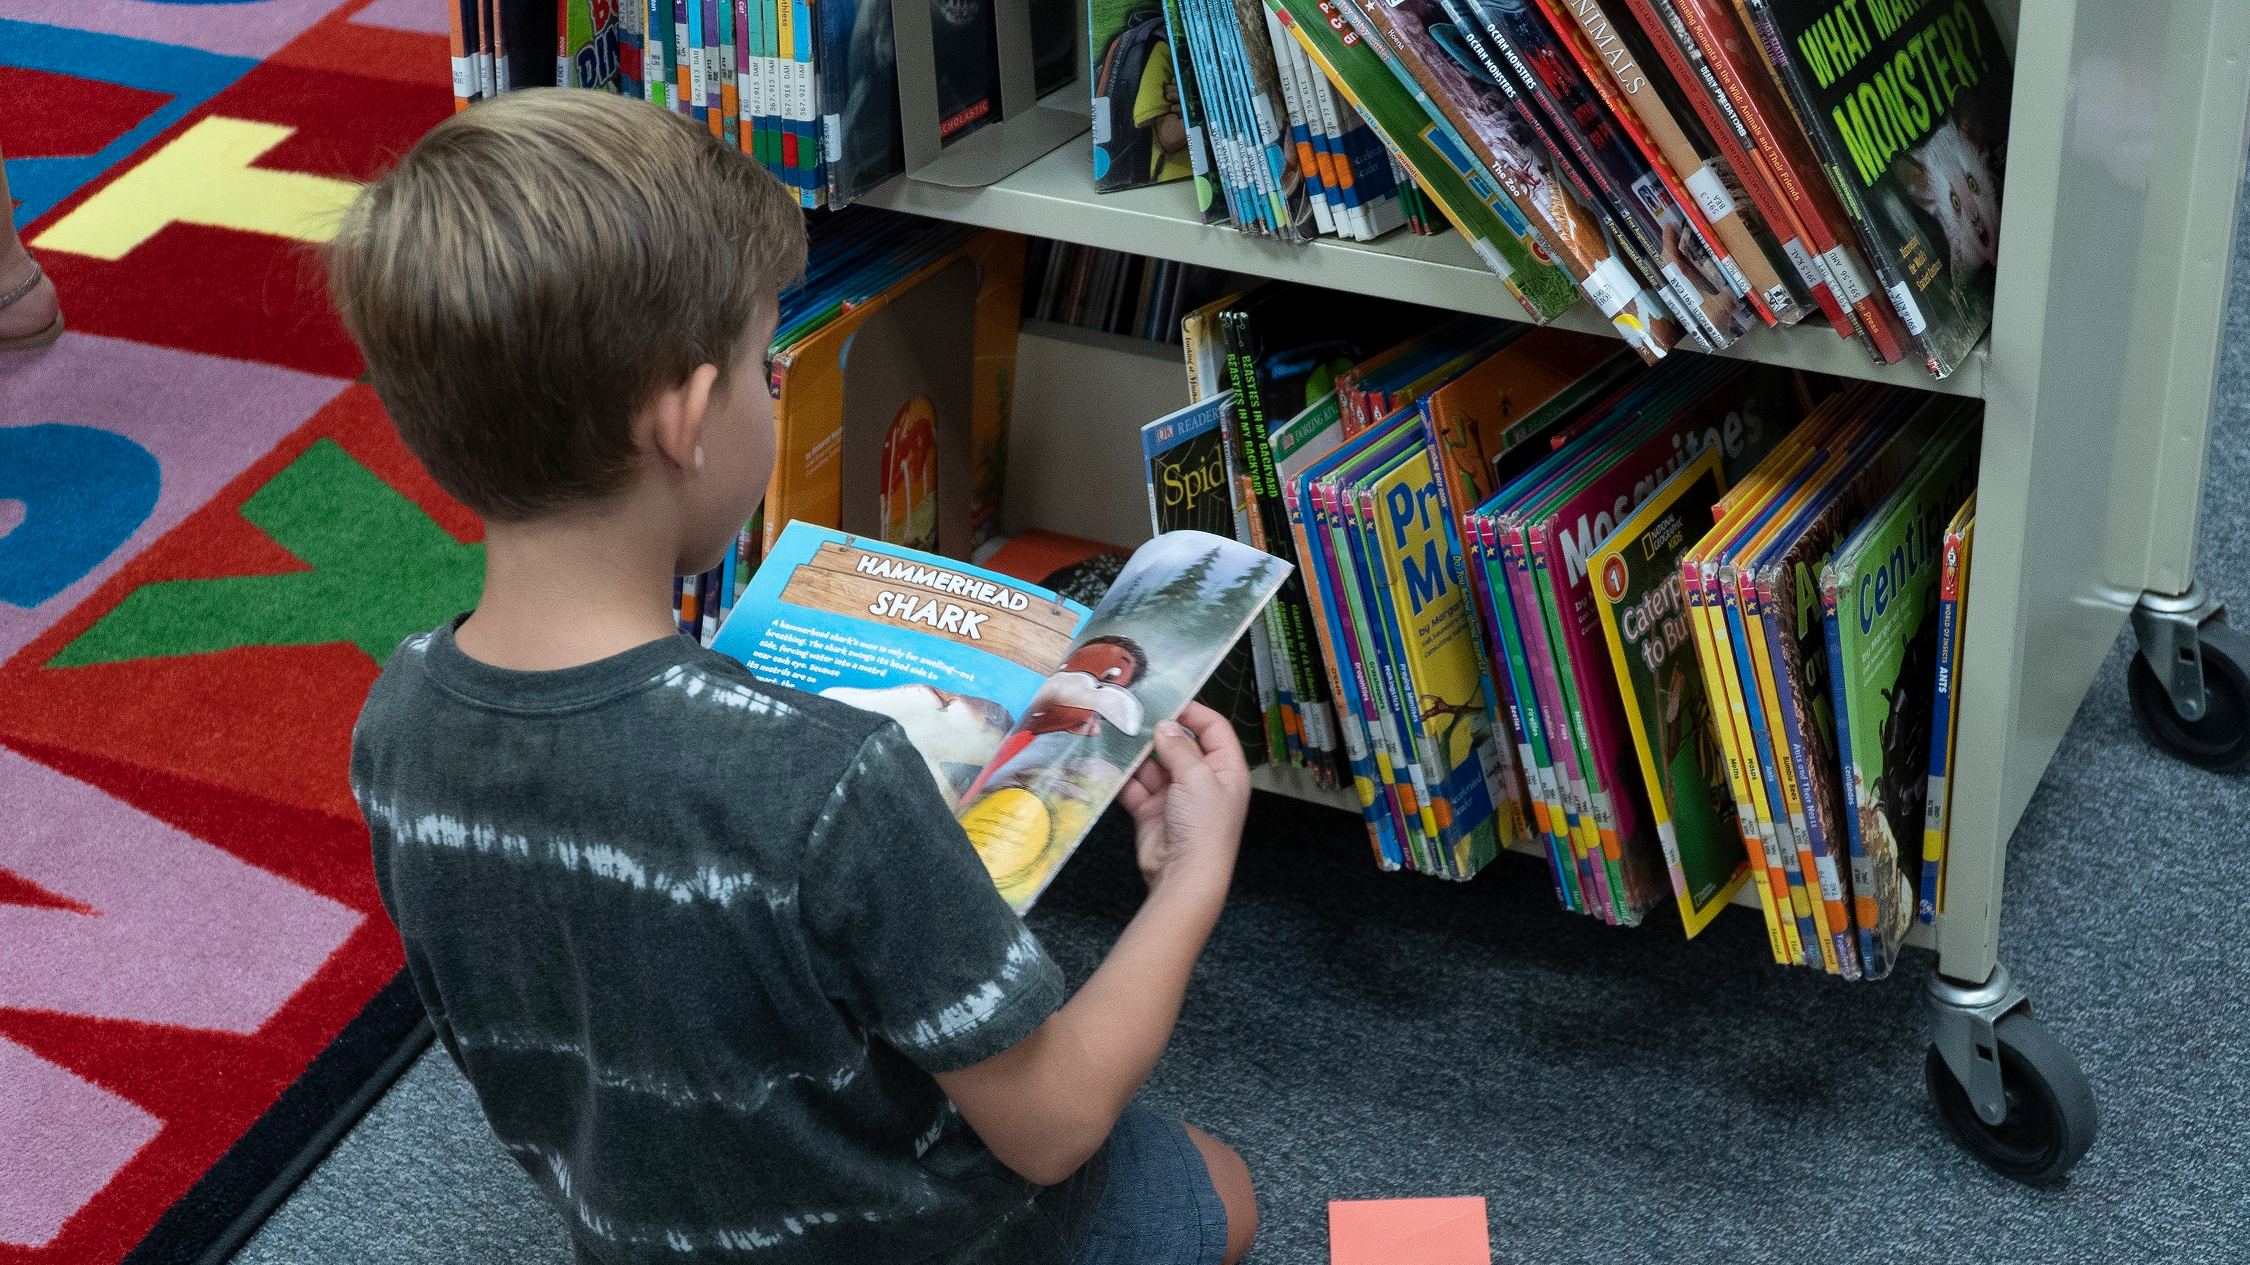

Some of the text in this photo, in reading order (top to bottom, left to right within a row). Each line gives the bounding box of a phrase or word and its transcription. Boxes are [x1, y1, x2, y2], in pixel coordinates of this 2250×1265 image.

[1351, 14, 1389, 60] Bitsy Cuties
[1657, 34, 1678, 63] ANIMALS
[1764, 19, 1790, 66] JESS KEATING
[1796, 0, 1872, 90] WHAT
[1466, 33, 1516, 98] OCEAN MONSTERS
[1487, 22, 1536, 89] OCEAN MONSTERS
[693, 68, 701, 101] 567.913
[753, 80, 761, 114] 567.915
[768, 78, 776, 111] 567.915
[783, 83, 792, 116] 567.918
[798, 84, 806, 116] 567.921
[1281, 76, 1290, 92] KLI
[1300, 80, 1309, 95] KLI
[1317, 88, 1327, 103] KLI
[1700, 65, 1746, 137] DEADLY PREDATORS
[1832, 0, 1989, 187] MONSTER?
[1693, 24, 1800, 201] Moments in the Wild: Animals and Their Friends
[1352, 104, 1418, 177] my little book of animals
[1491, 160, 1520, 197] The Zoo
[1699, 191, 1719, 217] 591.3
[1712, 194, 1725, 212] BEA
[1626, 215, 1657, 256] Free Augmented
[1609, 221, 1658, 286] Free Augmented Reality App
[1790, 248, 1815, 283] 591.5 KAL
[1829, 252, 1842, 266] AMU
[1593, 283, 1611, 301] 590.7
[1669, 277, 1692, 306] 591 CAR
[1723, 258, 1746, 293] 591 McG
[1817, 264, 1845, 310] 591.53 DEL
[1840, 269, 1861, 298] 591.56
[1664, 302, 1677, 318] CAR
[1863, 311, 1879, 333] Press
[1892, 292, 1916, 332] 591.6 KEA
[1185, 336, 1193, 365] Looking
[1227, 353, 1244, 405] BEASTIES
[1237, 408, 1247, 420] IN
[1240, 421, 1251, 437] MY
[1242, 355, 1278, 497] BEASTIES IN MY BACKYARD
[1157, 425, 1173, 441] DK
[1163, 446, 1228, 510] Spid
[1244, 440, 1263, 495] BACKYARD
[1651, 512, 1676, 541] NATIONAL
[1668, 533, 1684, 551] KIDS
[856, 554, 1029, 612] HAMMERHEAD
[1452, 555, 1470, 610] Do You Know
[1609, 569, 1622, 593] 1
[868, 590, 990, 640] SHARK
[771, 619, 919, 662] A hammerhead shark's nose is only for
[1941, 603, 1951, 664] WORLD OF INSECTS
[753, 650, 841, 677] near each eye. Because
[765, 628, 939, 681] breathing. The shark swings its head side to
[779, 644, 809, 659] forcing
[808, 653, 834, 664] water
[833, 658, 851, 667] into
[857, 664, 887, 678] nostril
[1641, 636, 1666, 674] to
[746, 660, 817, 684] its nostrils are so
[1331, 667, 1342, 696] Crickets
[1354, 661, 1369, 701] Dragonflies
[1369, 662, 1385, 710] Grasshoppers
[1383, 664, 1400, 711] Walkingsticks
[1938, 666, 1948, 693] ANTS
[1399, 663, 1418, 723] Praying Mantises
[1510, 705, 1522, 731] Beetles
[1527, 707, 1538, 737] Fireflies
[1560, 723, 1568, 740] Flies
[1573, 710, 1589, 750] Mosquitoes
[1730, 757, 1739, 779] Moths
[1745, 757, 1758, 781] Wasps
[1765, 765, 1774, 782] Ants
[1783, 757, 1799, 801] Bumble Bees
[1792, 742, 1817, 828] Ants and Their Nests
[1844, 765, 1856, 806] Centipedes
[1771, 927, 1783, 956] Howard
[1790, 940, 1800, 955] Hall
[1823, 938, 1837, 965] Howard
